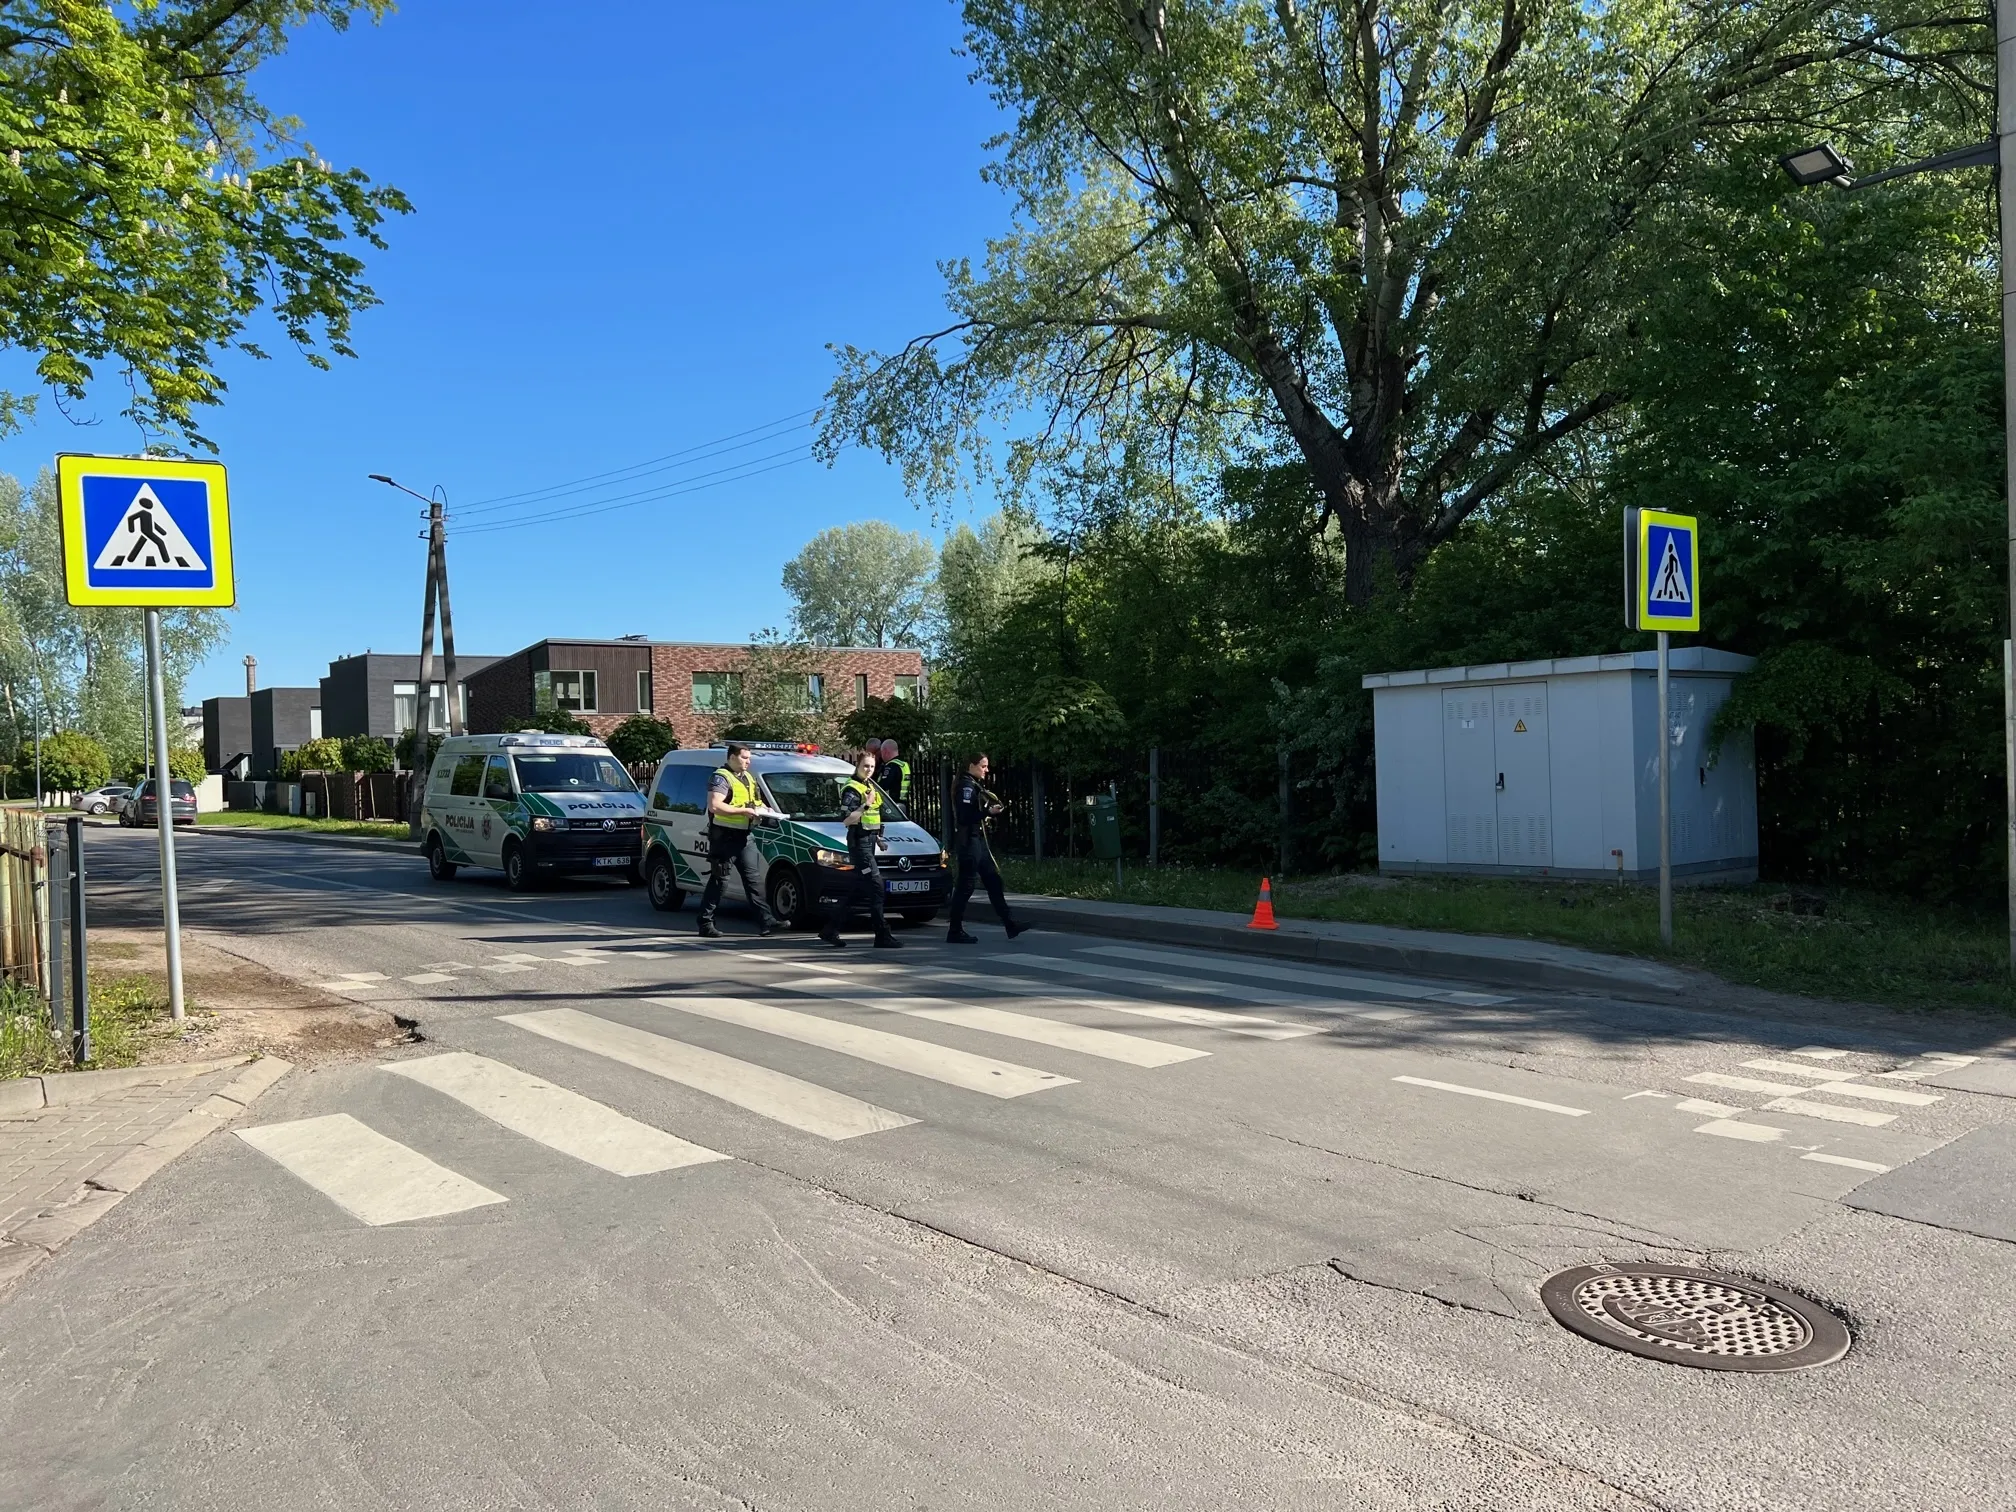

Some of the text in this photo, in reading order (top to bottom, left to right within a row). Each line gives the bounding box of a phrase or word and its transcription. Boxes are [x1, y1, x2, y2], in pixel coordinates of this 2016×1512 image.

[446, 814, 475, 829] POLICIJA
[891, 881, 929, 891] LGJ 716
